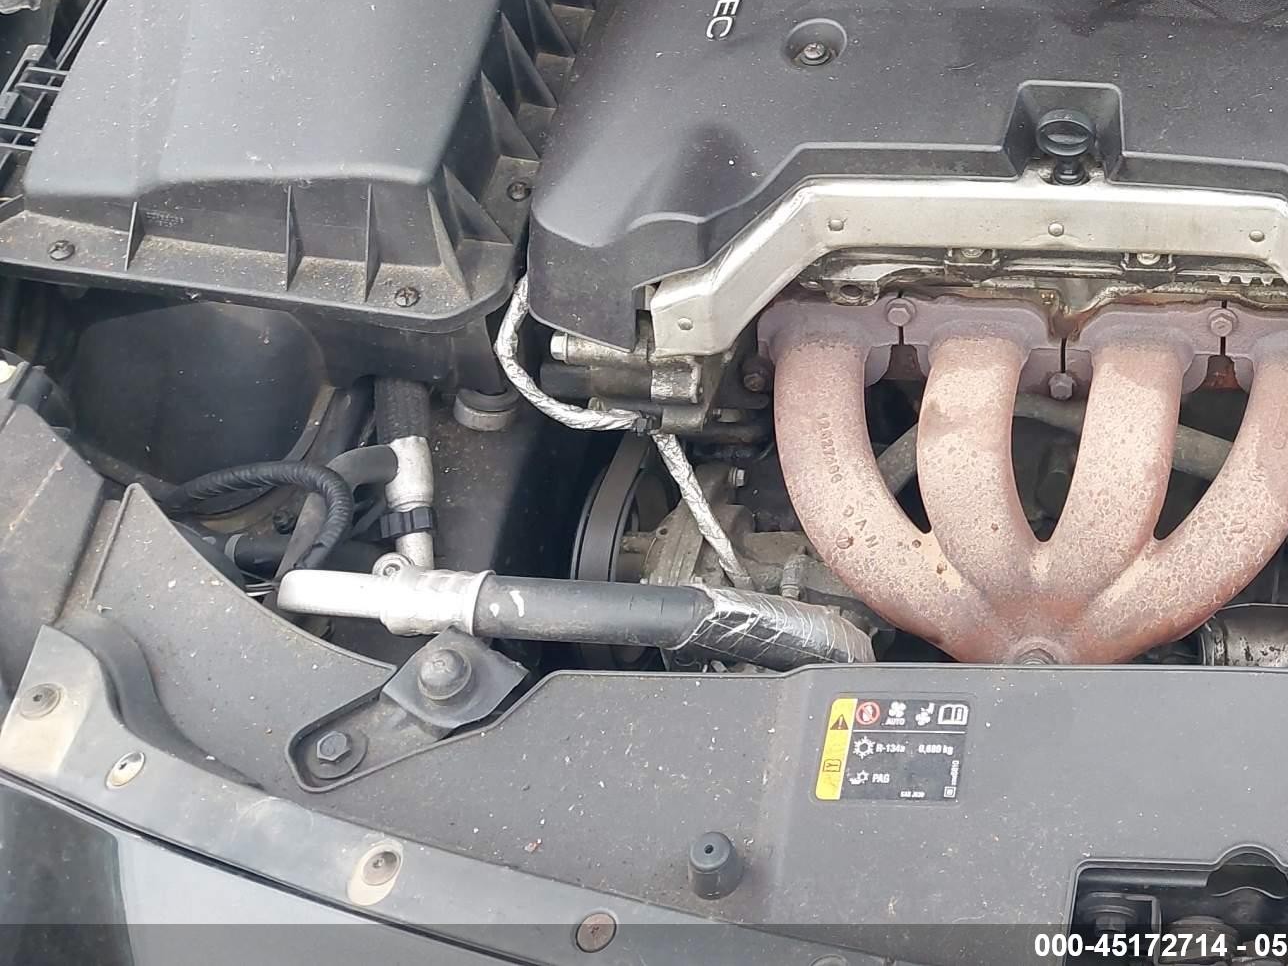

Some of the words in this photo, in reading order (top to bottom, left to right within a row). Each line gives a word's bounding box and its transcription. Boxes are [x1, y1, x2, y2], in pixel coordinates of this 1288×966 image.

[885, 717, 905, 726] AUTO
[875, 743, 906, 753] R-134a
[872, 773, 890, 783] PAG
